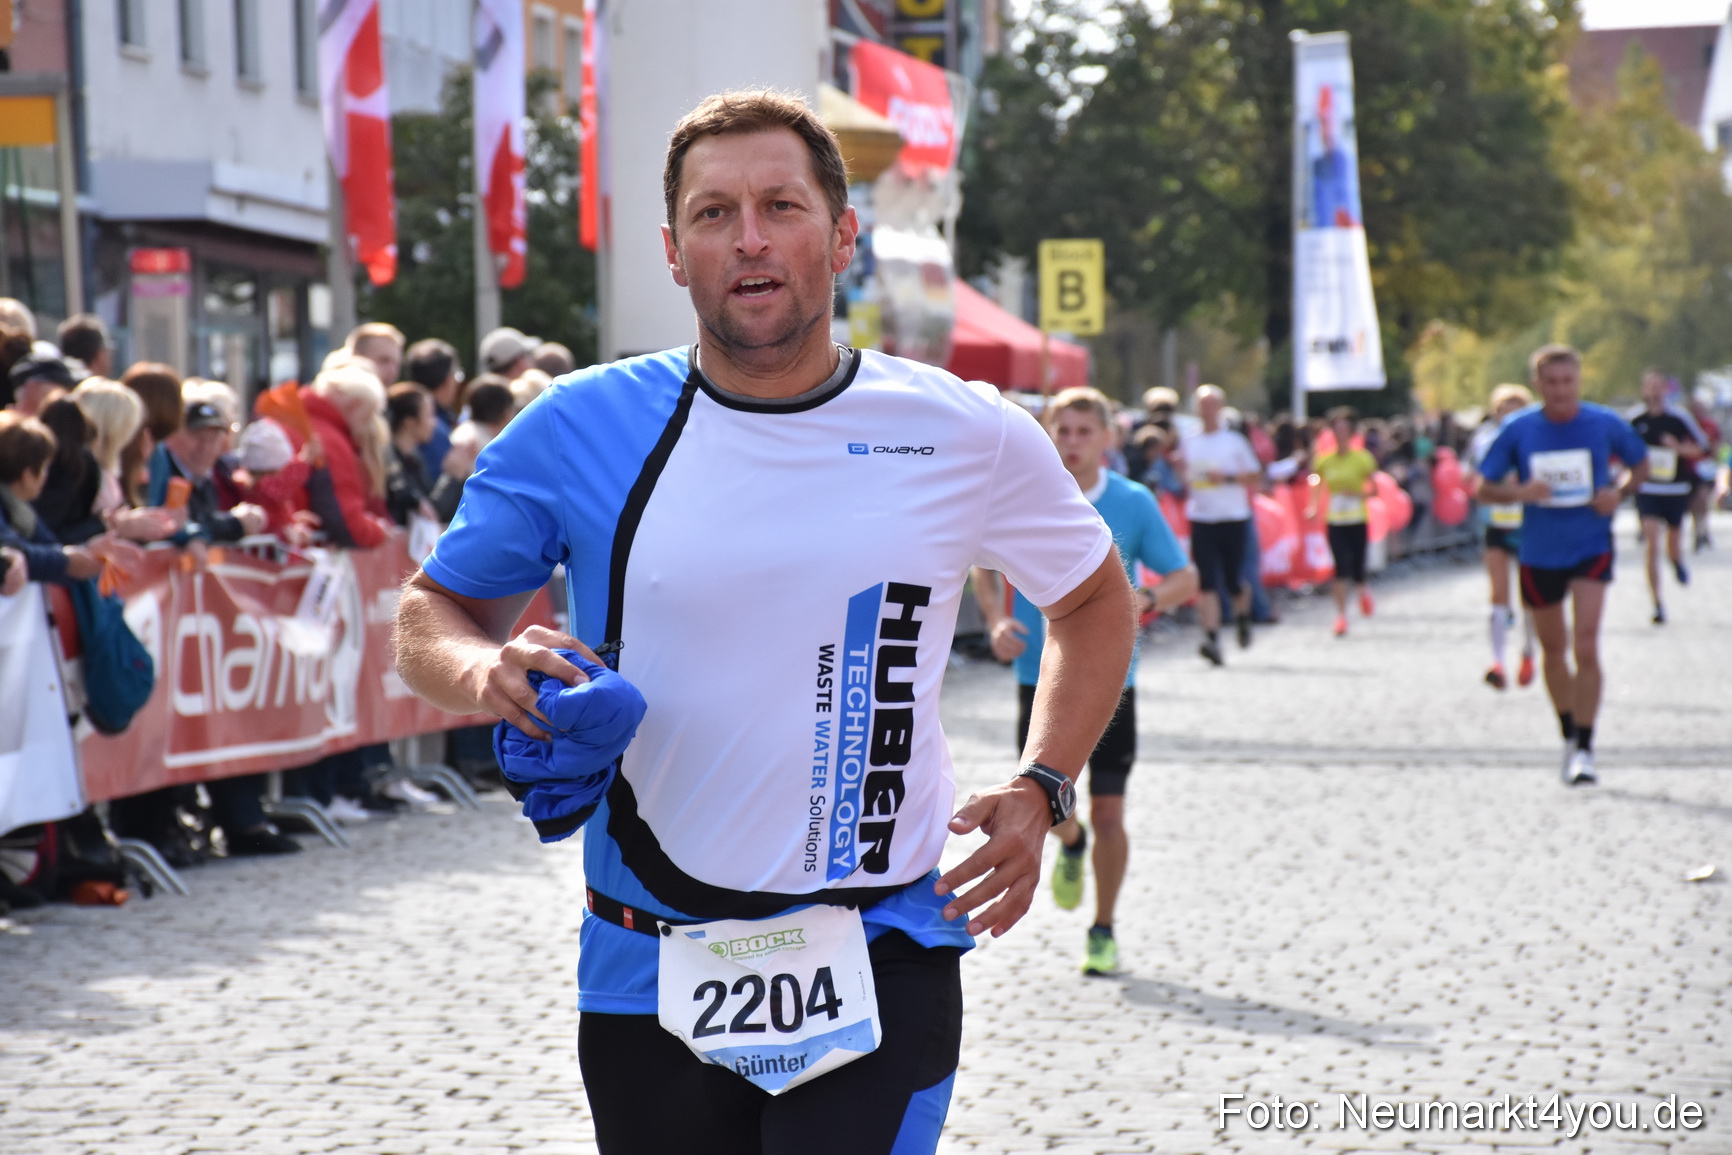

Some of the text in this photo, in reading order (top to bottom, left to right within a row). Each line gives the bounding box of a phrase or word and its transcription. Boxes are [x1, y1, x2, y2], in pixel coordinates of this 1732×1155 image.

[1058, 270, 1086, 312] B
[873, 446, 935, 456] owayo
[803, 643, 835, 873] WASTE WATER Solutions
[832, 643, 870, 869] TECHNOLOGY
[849, 581, 933, 877] HUBER
[729, 928, 807, 957] BOCK
[692, 966, 843, 1040] 2204
[735, 1052, 808, 1078] Günter
